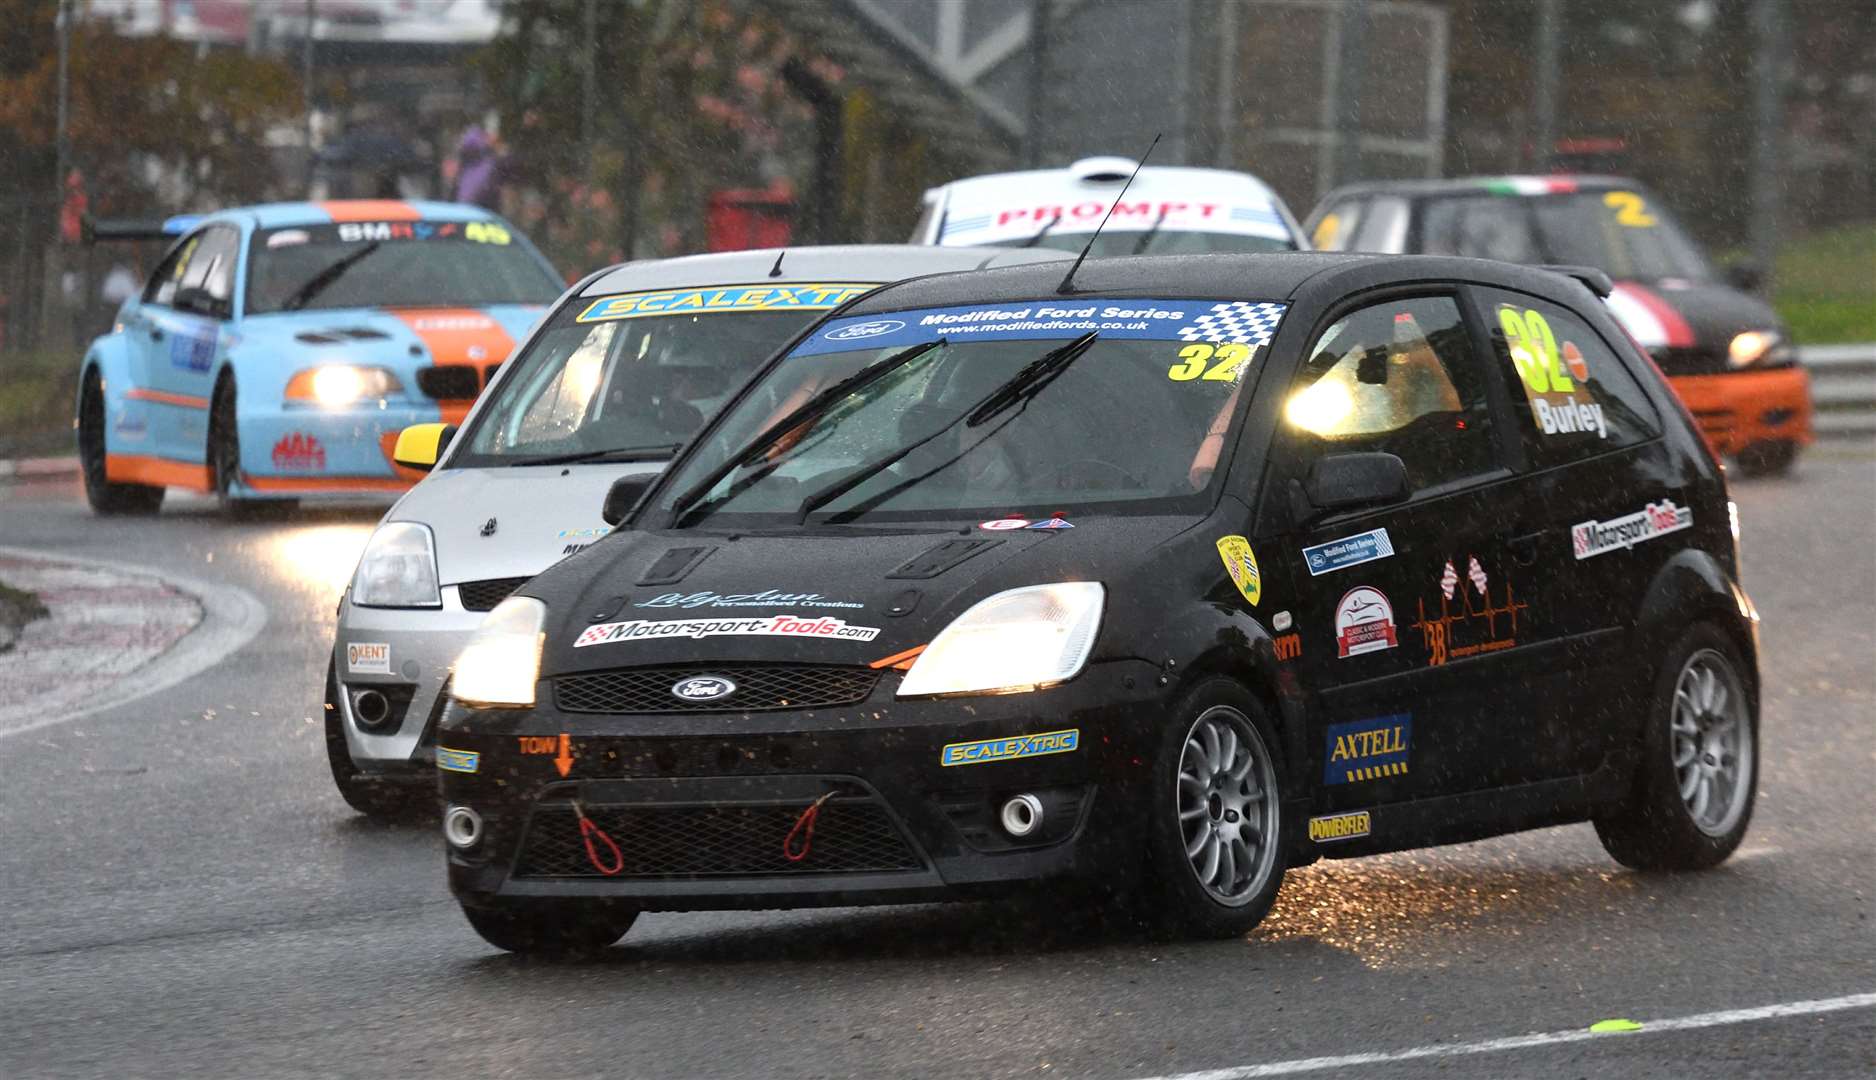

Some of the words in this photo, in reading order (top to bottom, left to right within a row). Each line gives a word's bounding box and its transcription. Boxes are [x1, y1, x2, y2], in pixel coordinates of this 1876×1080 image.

[998, 202, 1220, 226] PROMPT
[1603, 190, 1658, 227] 2
[920, 309, 1031, 325] Modified
[1034, 307, 1096, 320] Ford
[1100, 307, 1185, 320] Series
[937, 320, 1149, 334] www.modifiedfords.co.uk
[838, 322, 892, 338] Ford
[1499, 308, 1575, 393] 32
[1168, 343, 1250, 382] 32
[1534, 396, 1607, 439] Burley
[800, 600, 864, 609] Creations
[607, 617, 876, 640] Motorsport-Tools.com
[359, 645, 387, 659] KENT
[682, 680, 722, 696] Ford
[518, 736, 558, 754] TOW
[950, 734, 1073, 761] SCALEXTRIC
[1331, 726, 1406, 762] AXTELL
[1311, 815, 1369, 838] POWERFLEX
